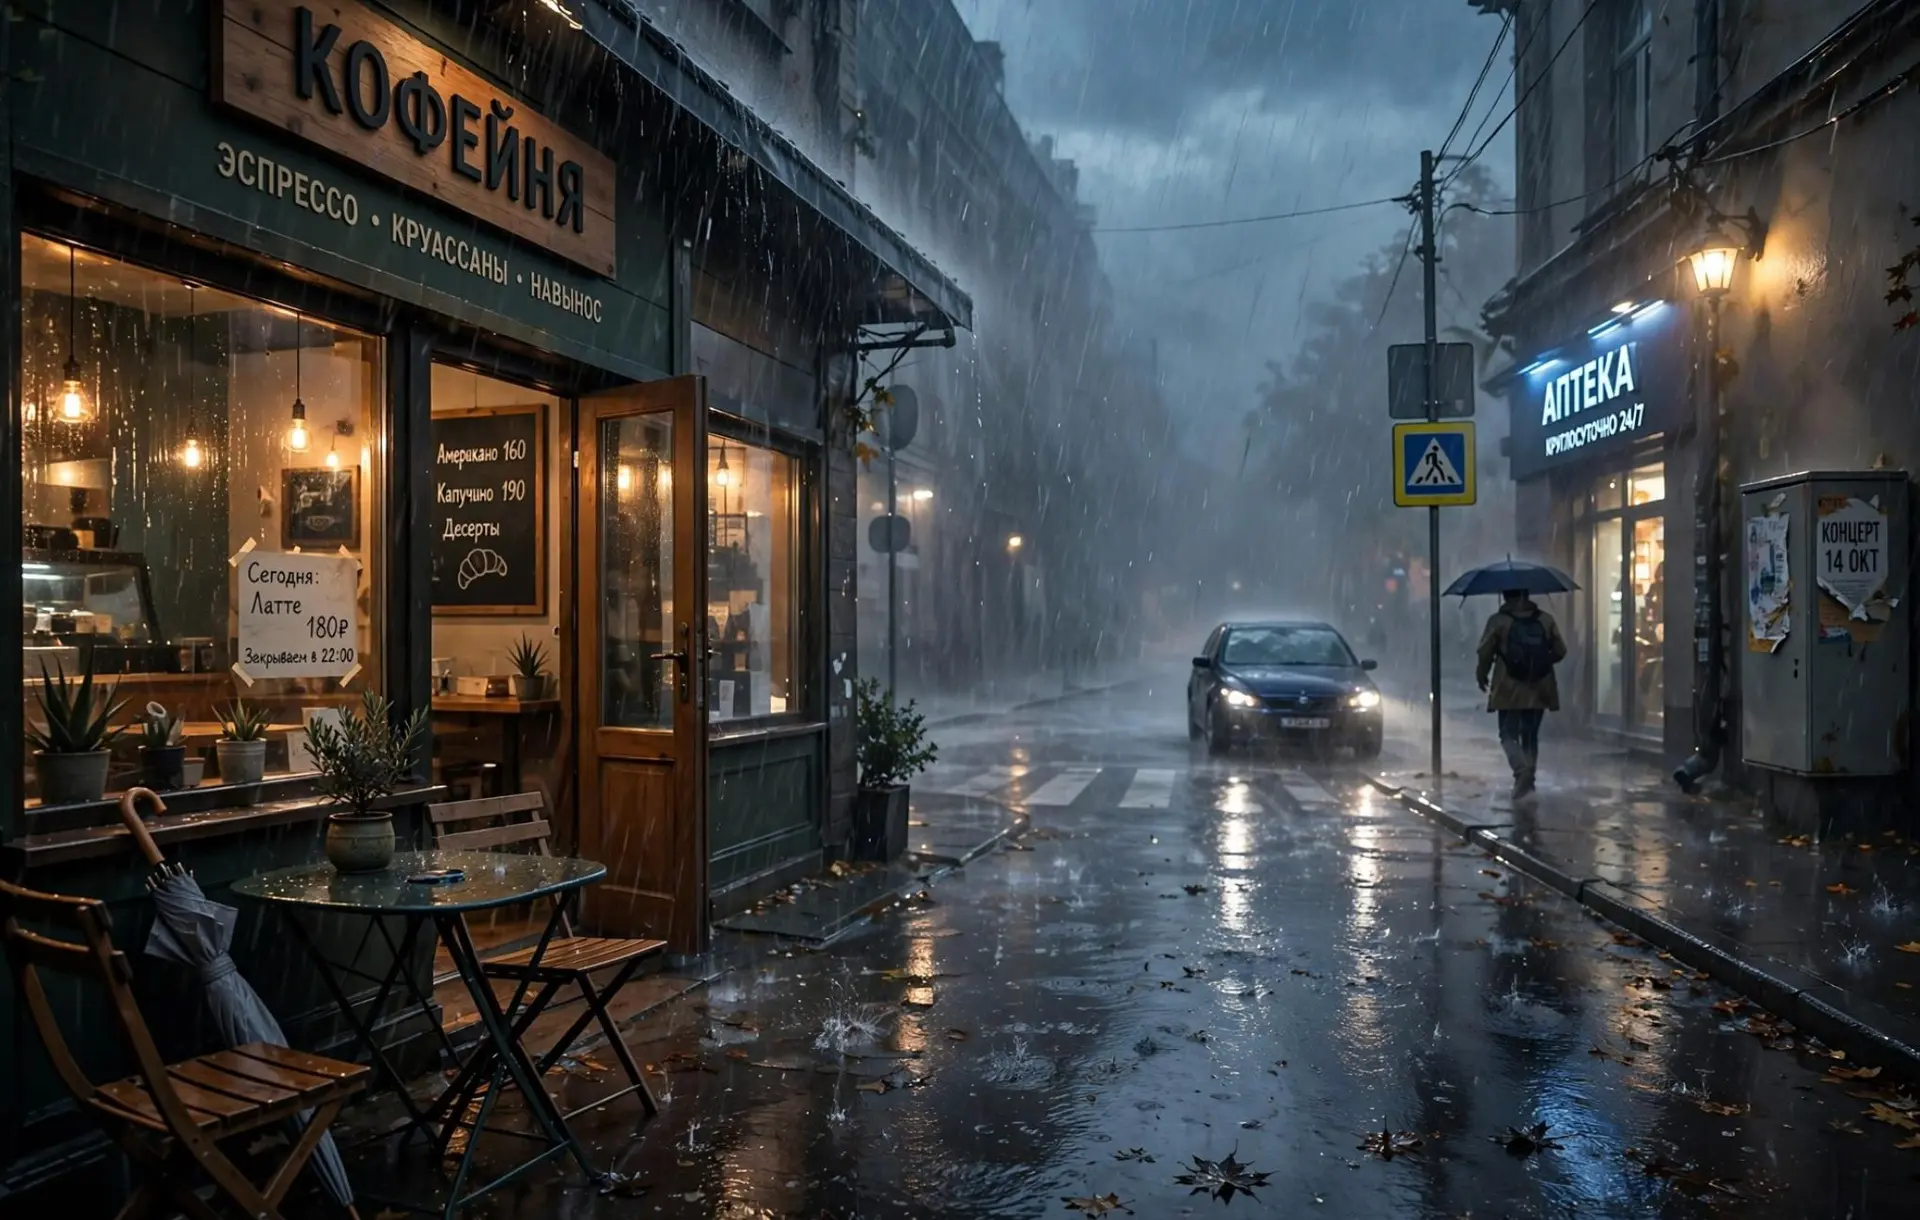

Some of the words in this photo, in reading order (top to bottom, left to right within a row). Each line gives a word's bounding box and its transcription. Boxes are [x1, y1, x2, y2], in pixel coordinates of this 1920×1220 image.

[294, 7, 584, 234] КОФЕЙНЯ
[216, 142, 359, 227] ЭСПРЕССО
[391, 213, 508, 287] КРУАССАНЫ
[530, 271, 603, 324] НАВЫНОС
[1542, 343, 1635, 426] АПТЕКА
[1545, 413, 1618, 456] КРУГЛОСУТОЧНО
[1619, 403, 1645, 431] 24/7
[437, 443, 499, 471] Американо
[503, 439, 526, 461] 160
[437, 482, 494, 509] Капучино
[502, 479, 526, 501] 190
[442, 518, 500, 544] Десерты
[1822, 521, 1881, 546] КОНЦЕРТ
[247, 561, 320, 588] Сегодня:
[1825, 550, 1844, 573] 14
[1849, 549, 1880, 573] ОКТ
[250, 591, 303, 615] Латте
[306, 615, 349, 638] 180₽
[244, 647, 308, 669] Закрываем
[310, 651, 318, 663] в
[320, 647, 355, 663] 22:00
